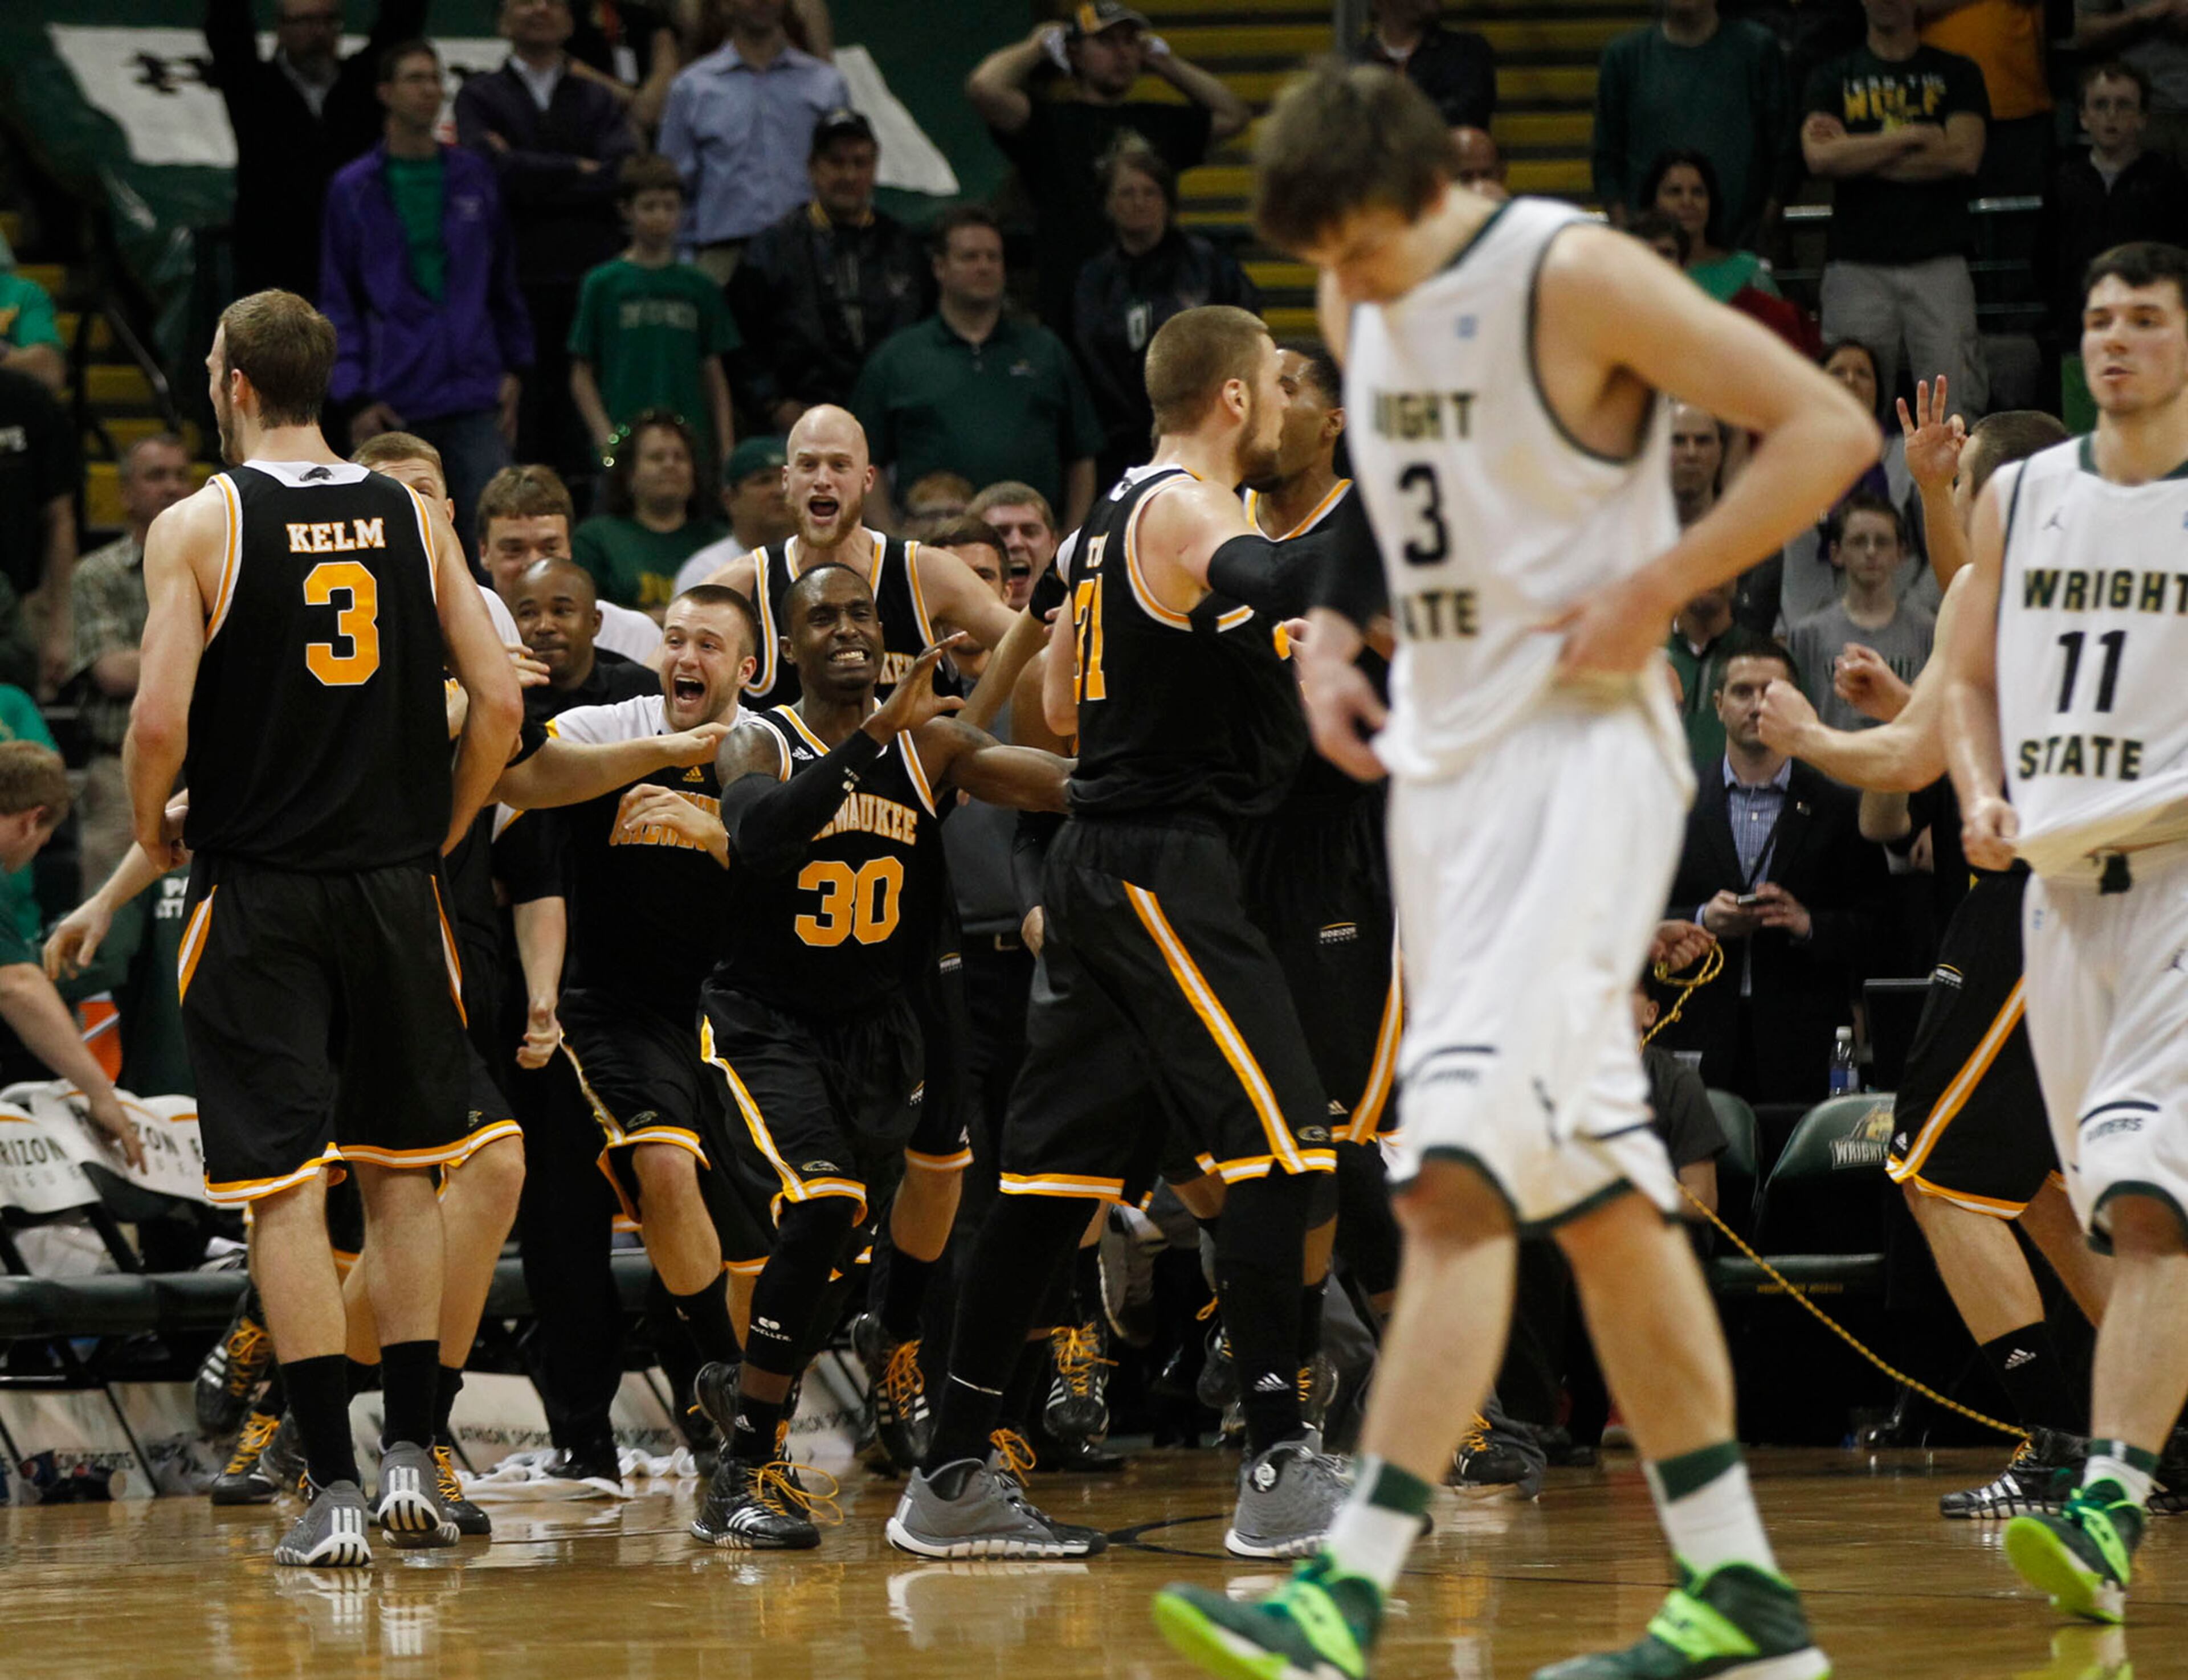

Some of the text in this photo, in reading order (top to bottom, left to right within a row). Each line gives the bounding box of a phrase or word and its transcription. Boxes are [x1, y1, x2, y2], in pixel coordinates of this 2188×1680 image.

[285, 517, 386, 553] KELM
[1398, 460, 1451, 565] 3
[303, 561, 380, 686] 3
[2057, 630, 2126, 714] 11
[2018, 734, 2144, 782] STATE
[794, 856, 904, 946] 30
[750, 1324, 789, 1342] MUELLER
